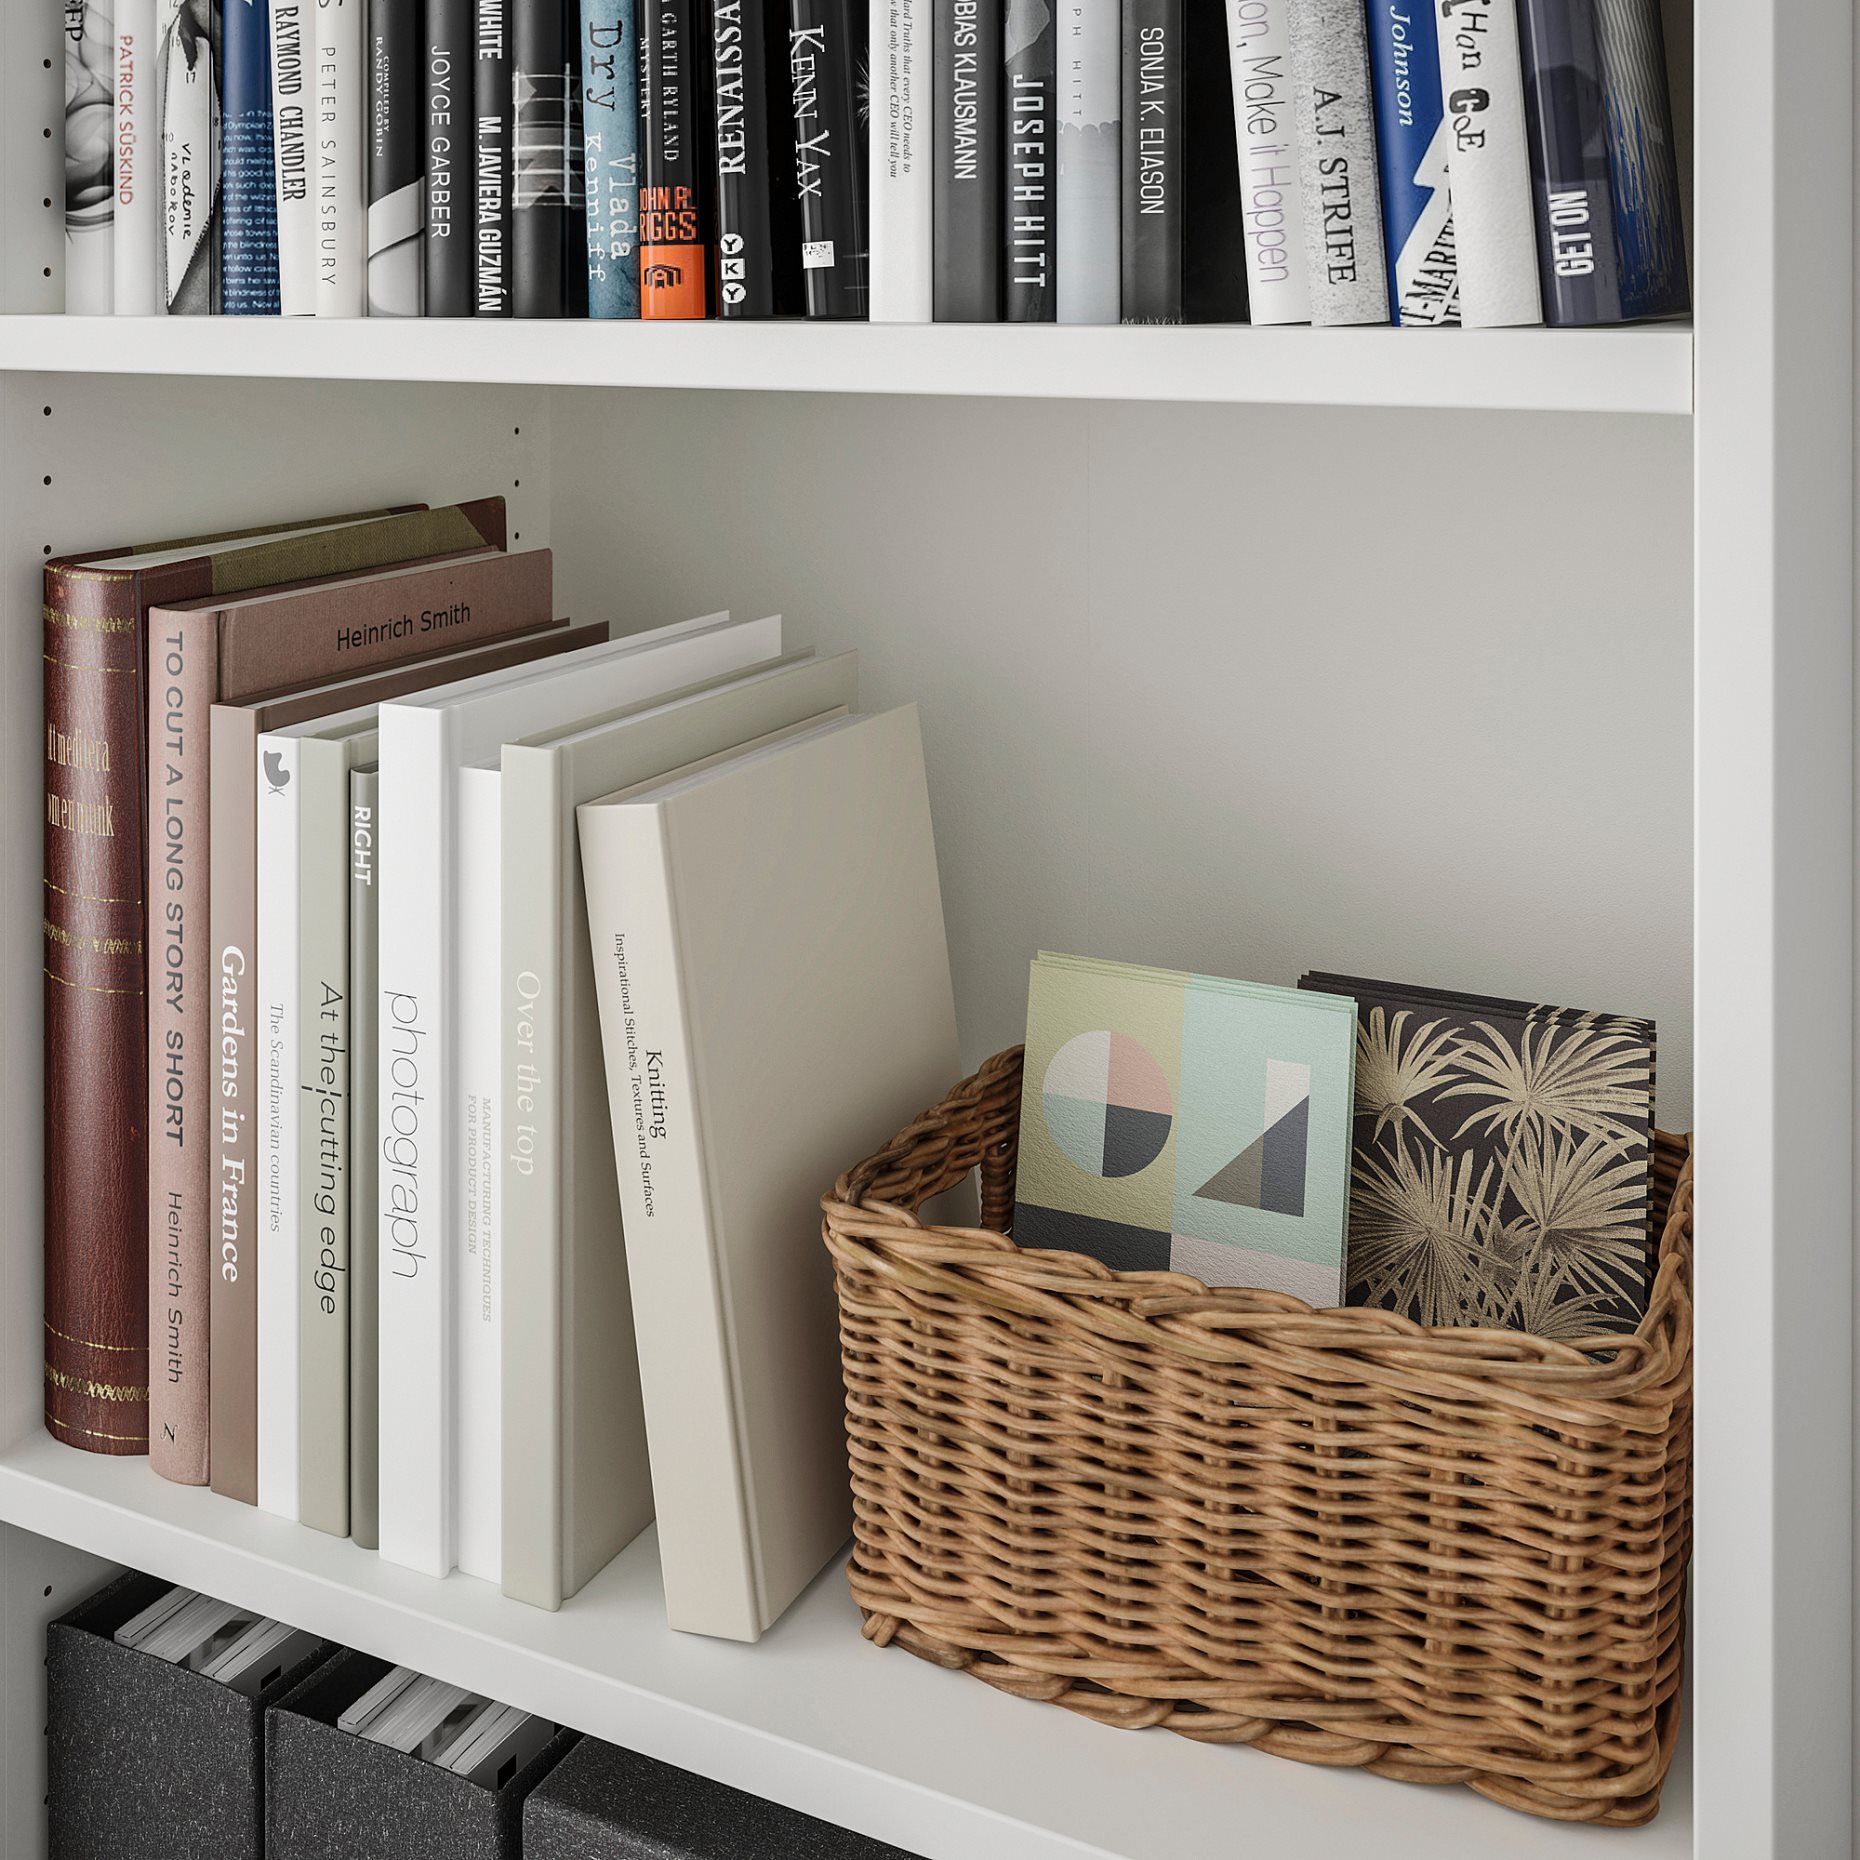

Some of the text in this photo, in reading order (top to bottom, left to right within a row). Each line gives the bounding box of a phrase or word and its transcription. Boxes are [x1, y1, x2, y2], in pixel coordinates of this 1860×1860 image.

[479, 0, 502, 60] WHITE
[586, 19, 623, 113] Dry
[887, 30, 900, 52] only
[889, 8, 900, 28] that
[889, 53, 900, 93] another
[903, 22, 913, 53] Truths
[903, 55, 913, 75] that
[1390, 5, 1414, 127] Johnson
[119, 35, 136, 206] PATRICK SÜSKIND
[275, 5, 306, 202] RAYMOND CHANDLER
[375, 36, 384, 157] RANDY GOBIN
[383, 118, 390, 132] BY
[431, 45, 451, 239] JOYCE GARBER
[661, 12, 680, 162] GARTH RYLAND
[889, 94, 900, 119] CEO
[889, 121, 900, 141] will
[900, 77, 911, 104] every
[902, 105, 913, 131] CEO
[903, 132, 913, 161] needs
[953, 0, 977, 179] BIAS KLAUSMANN
[1072, 60, 1082, 116] HITT
[1140, 27, 1165, 214] SONJA K. ELIASON
[1236, 0, 1292, 283] on, Make it Happen
[238, 169, 263, 179] good
[321, 47, 337, 286] PETER SAINSBURY
[585, 131, 606, 282] Kenniff
[608, 152, 638, 261] Vlada
[887, 158, 898, 178] you
[889, 142, 900, 158] tell
[903, 163, 912, 174] to
[1013, 73, 1046, 288] JOSEPH HITT
[1313, 86, 1357, 285] A.J. STRIFE
[478, 116, 508, 311] M. JAVIERA GUZMÁN
[1549, 190, 1594, 277] GET ON
[336, 602, 471, 651] Heinrich Smith
[164, 631, 185, 1148] TO CUT A LONG STORY SHORT
[354, 804, 372, 886] RIGHT
[221, 944, 246, 1283] Gardens in France
[269, 1003, 285, 1233] The Scandinavian countries
[509, 970, 543, 1177] Over the top
[614, 933, 655, 1219] Inspirational Stitches, Textures and Surfaces
[645, 1049, 668, 1141] Knitting
[313, 980, 346, 1315] At the cutting edge
[383, 990, 427, 1280] photograph
[467, 1094, 477, 1255] FOR PRODUCT DESIGN
[482, 1097, 492, 1323] MANUFACTURING TECHNIQUES
[166, 1191, 182, 1385] Heinrich Smith
